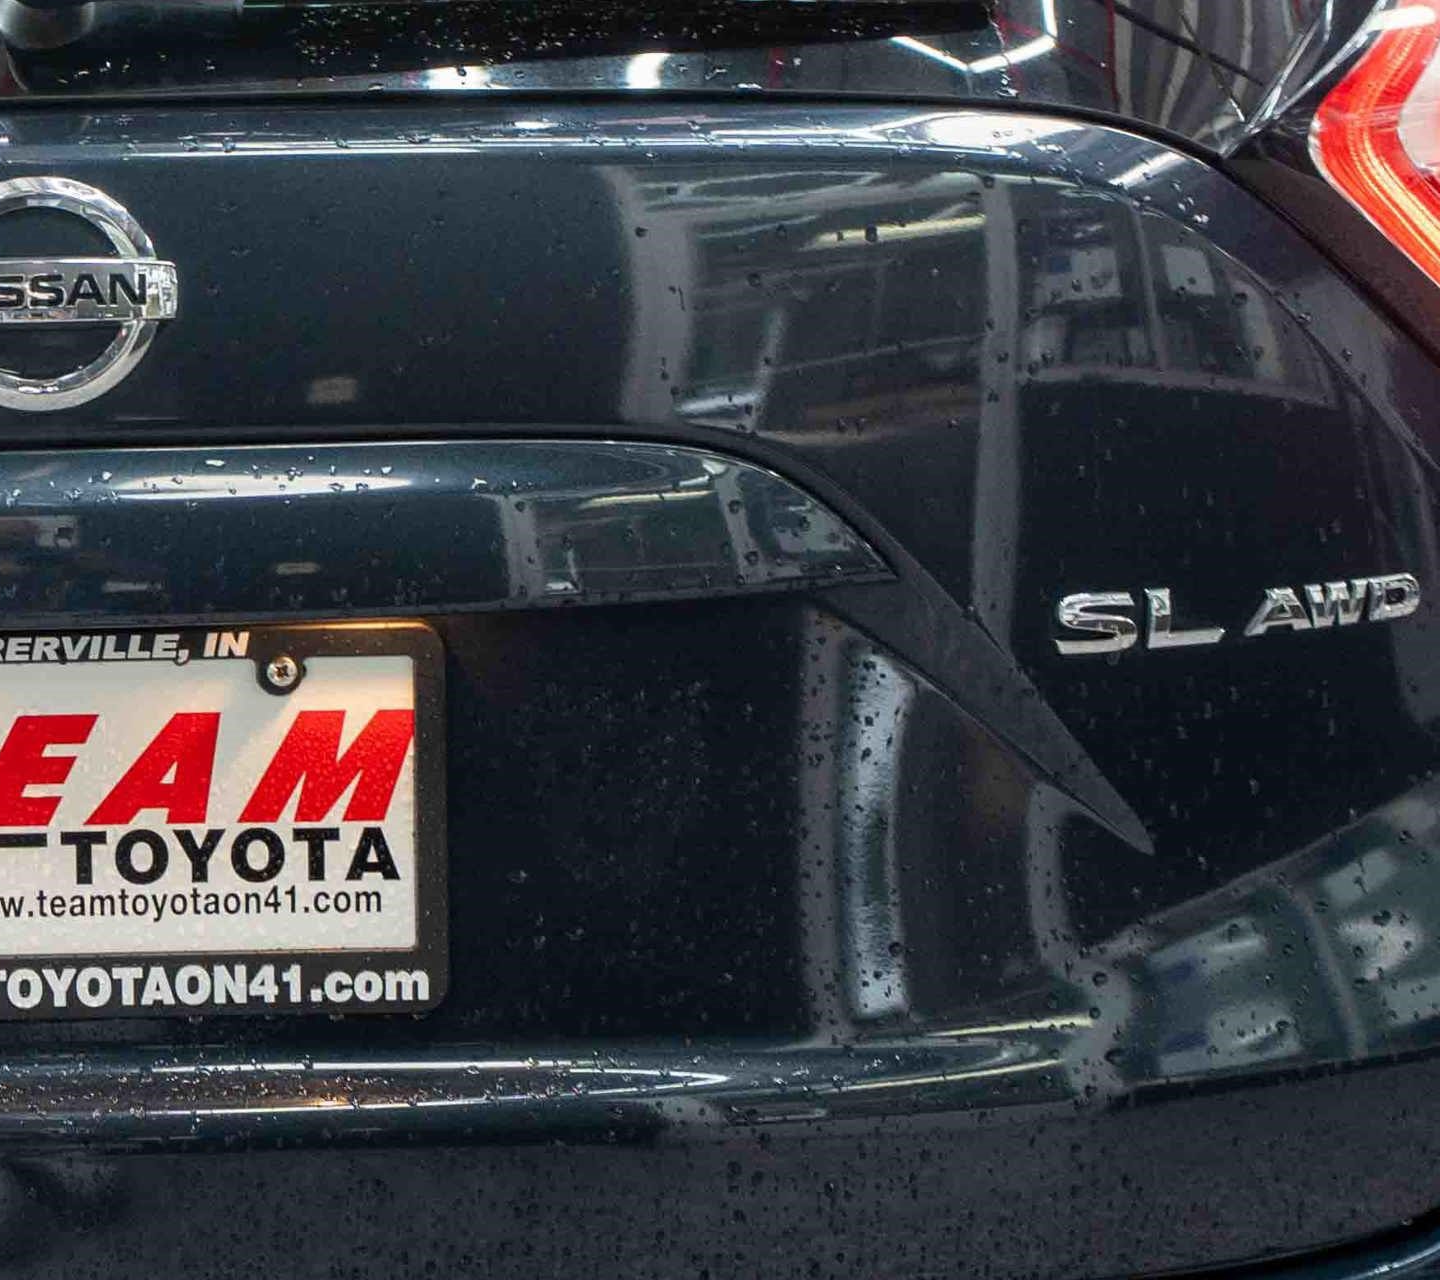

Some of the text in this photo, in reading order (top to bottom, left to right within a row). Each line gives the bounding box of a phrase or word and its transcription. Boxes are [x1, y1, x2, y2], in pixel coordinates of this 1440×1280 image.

[1054, 572, 1420, 655] SL AWD
[204, 632, 250, 658] IN
[59, 827, 401, 885] TOYOTA
